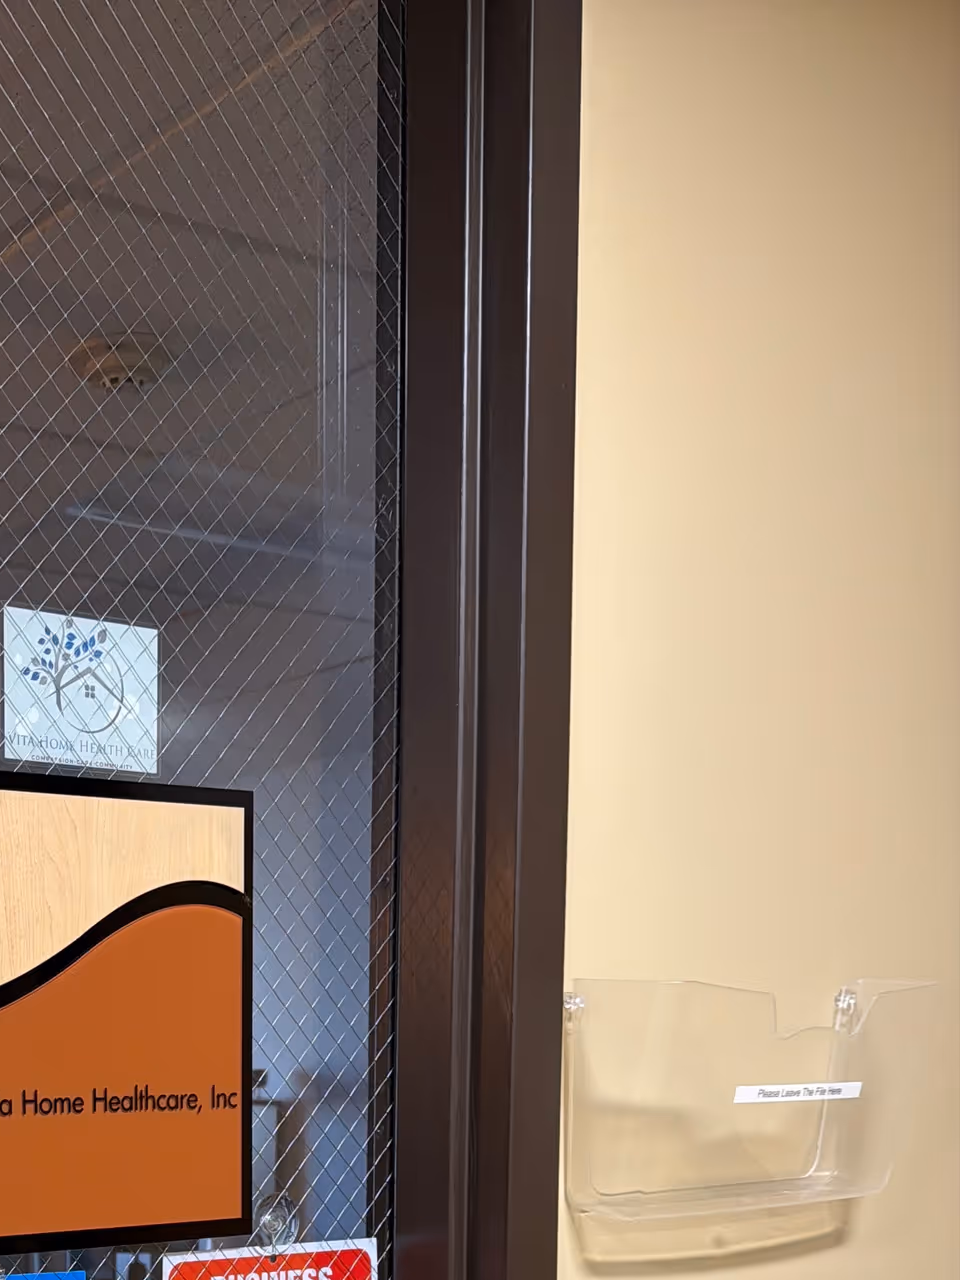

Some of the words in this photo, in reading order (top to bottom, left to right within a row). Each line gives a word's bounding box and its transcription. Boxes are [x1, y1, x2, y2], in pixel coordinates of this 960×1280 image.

[8, 732, 36, 747] VITA
[757, 1088, 780, 1098] Please
[802, 1087, 814, 1097] The
[21, 1087, 85, 1117] Home
[92, 1084, 203, 1115] Healthcare,
[210, 1084, 238, 1110] Inc
